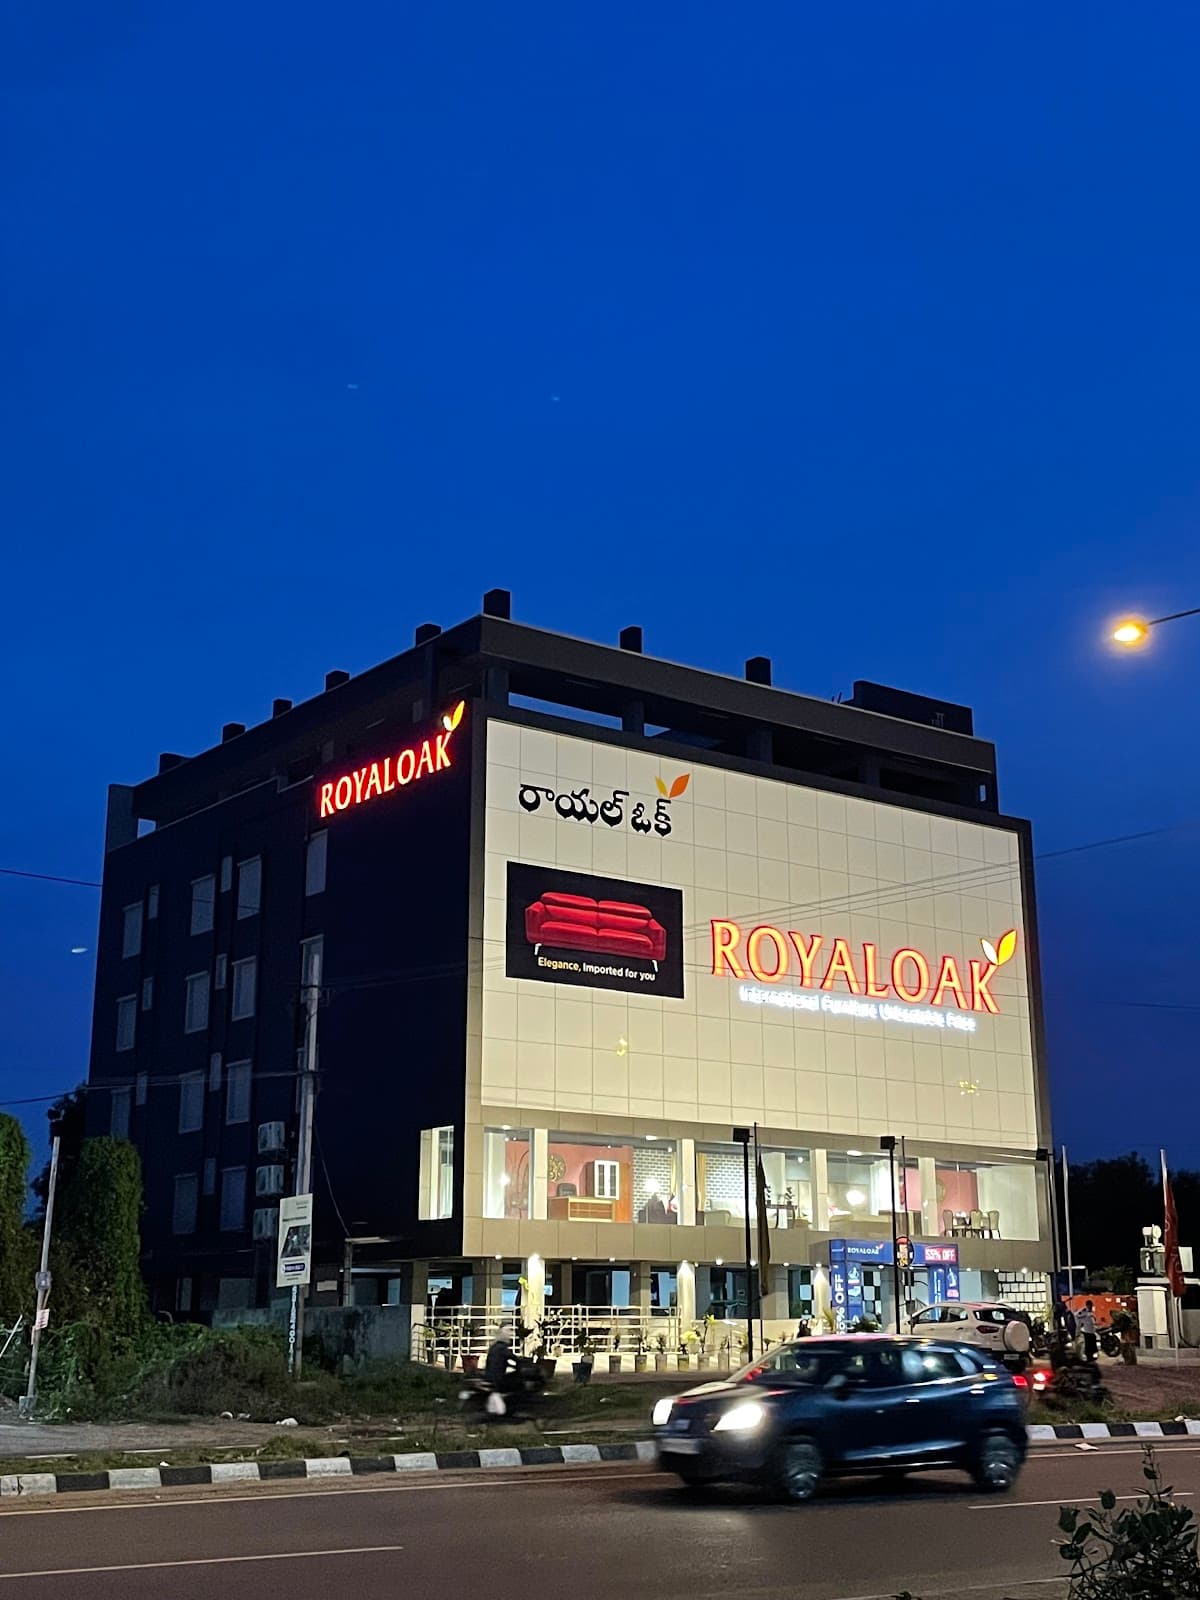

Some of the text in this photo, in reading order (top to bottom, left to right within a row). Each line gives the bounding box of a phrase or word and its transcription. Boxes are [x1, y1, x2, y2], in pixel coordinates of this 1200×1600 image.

[320, 732, 452, 818] ROYALOAK
[518, 783, 672, 837] రాయల్ ఓక్
[537, 957, 656, 981] Elegance, Imported for you
[710, 919, 1001, 1014] ROYALOAK
[834, 1273, 845, 1304] OFF
